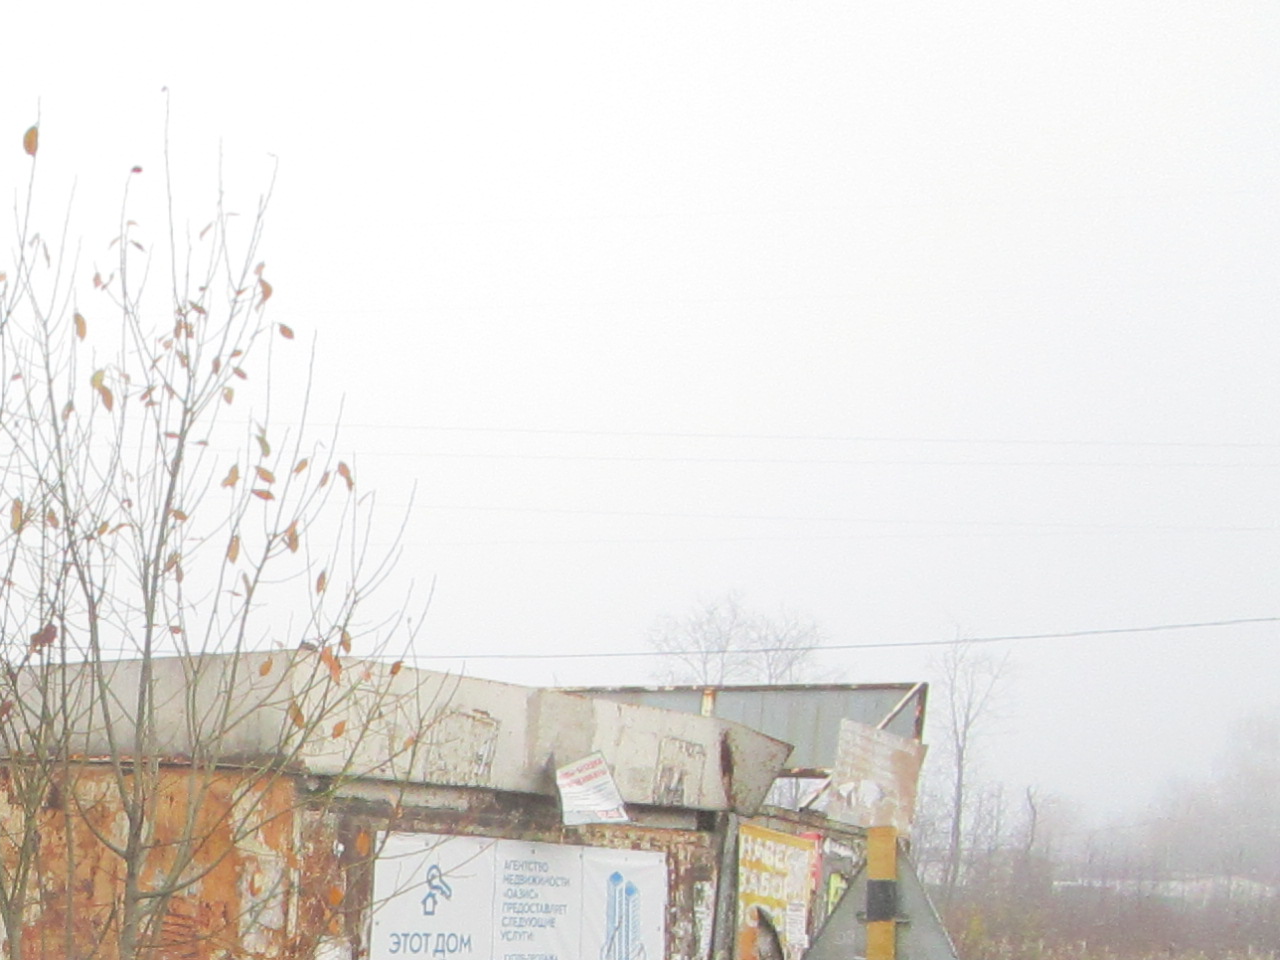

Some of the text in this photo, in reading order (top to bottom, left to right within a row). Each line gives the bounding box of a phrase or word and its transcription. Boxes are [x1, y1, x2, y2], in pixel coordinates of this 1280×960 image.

[504, 860, 549, 872] АГЕНТСТВО
[503, 874, 570, 887] НЕДВИЖИМОСТИ
[502, 902, 567, 915] ПРЕДОСТАВЛЯЕТ
[501, 917, 556, 928] СЛЕДУЮЩИЕ
[389, 932, 472, 957] ЭТОТ ДОМ
